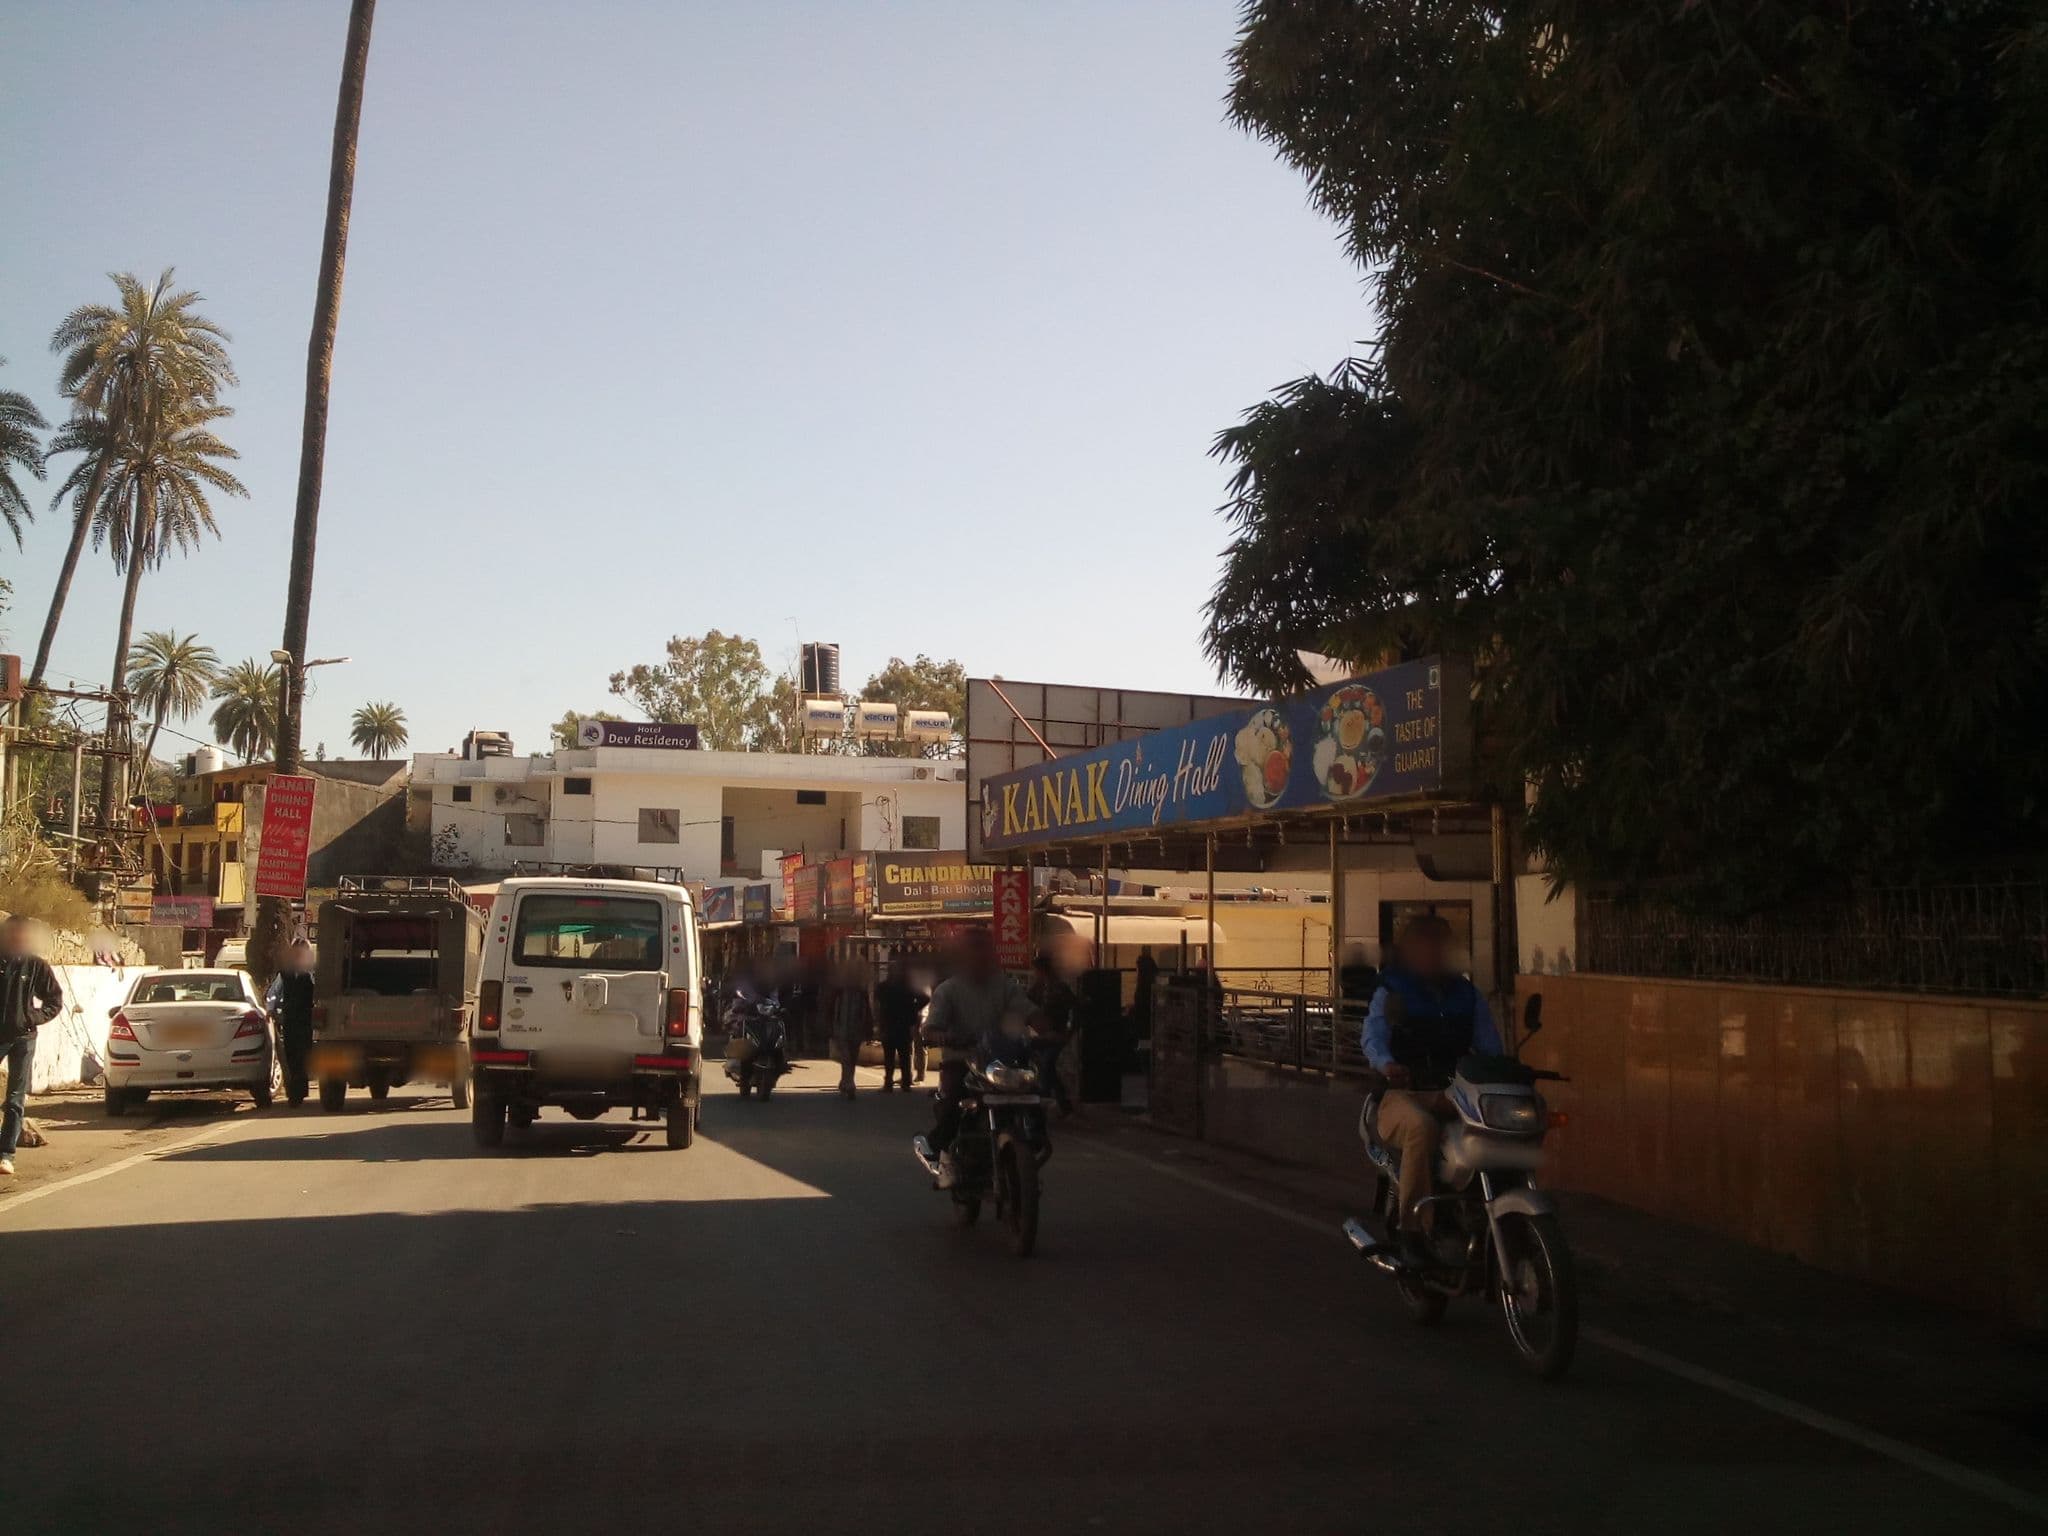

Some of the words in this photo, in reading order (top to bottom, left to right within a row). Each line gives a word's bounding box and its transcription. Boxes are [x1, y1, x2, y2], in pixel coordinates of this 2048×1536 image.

[1406, 690, 1424, 710] THE
[637, 726, 662, 734] Hotel
[1394, 721, 1422, 743] TASTE
[1424, 718, 1437, 739] OF
[608, 734, 631, 744] Dev
[634, 735, 692, 749] Residency
[1394, 747, 1437, 774] GUJARAT
[267, 776, 315, 794] KANAK
[1002, 759, 1113, 837] KANAK
[1114, 750, 1169, 827] Dining
[1173, 733, 1228, 804] Hall
[271, 793, 310, 807] DINING
[274, 807, 303, 820] HALL
[904, 887, 923, 897] Dal
[956, 885, 994, 897] Bhojna
[1001, 874, 1022, 942] KANAK
